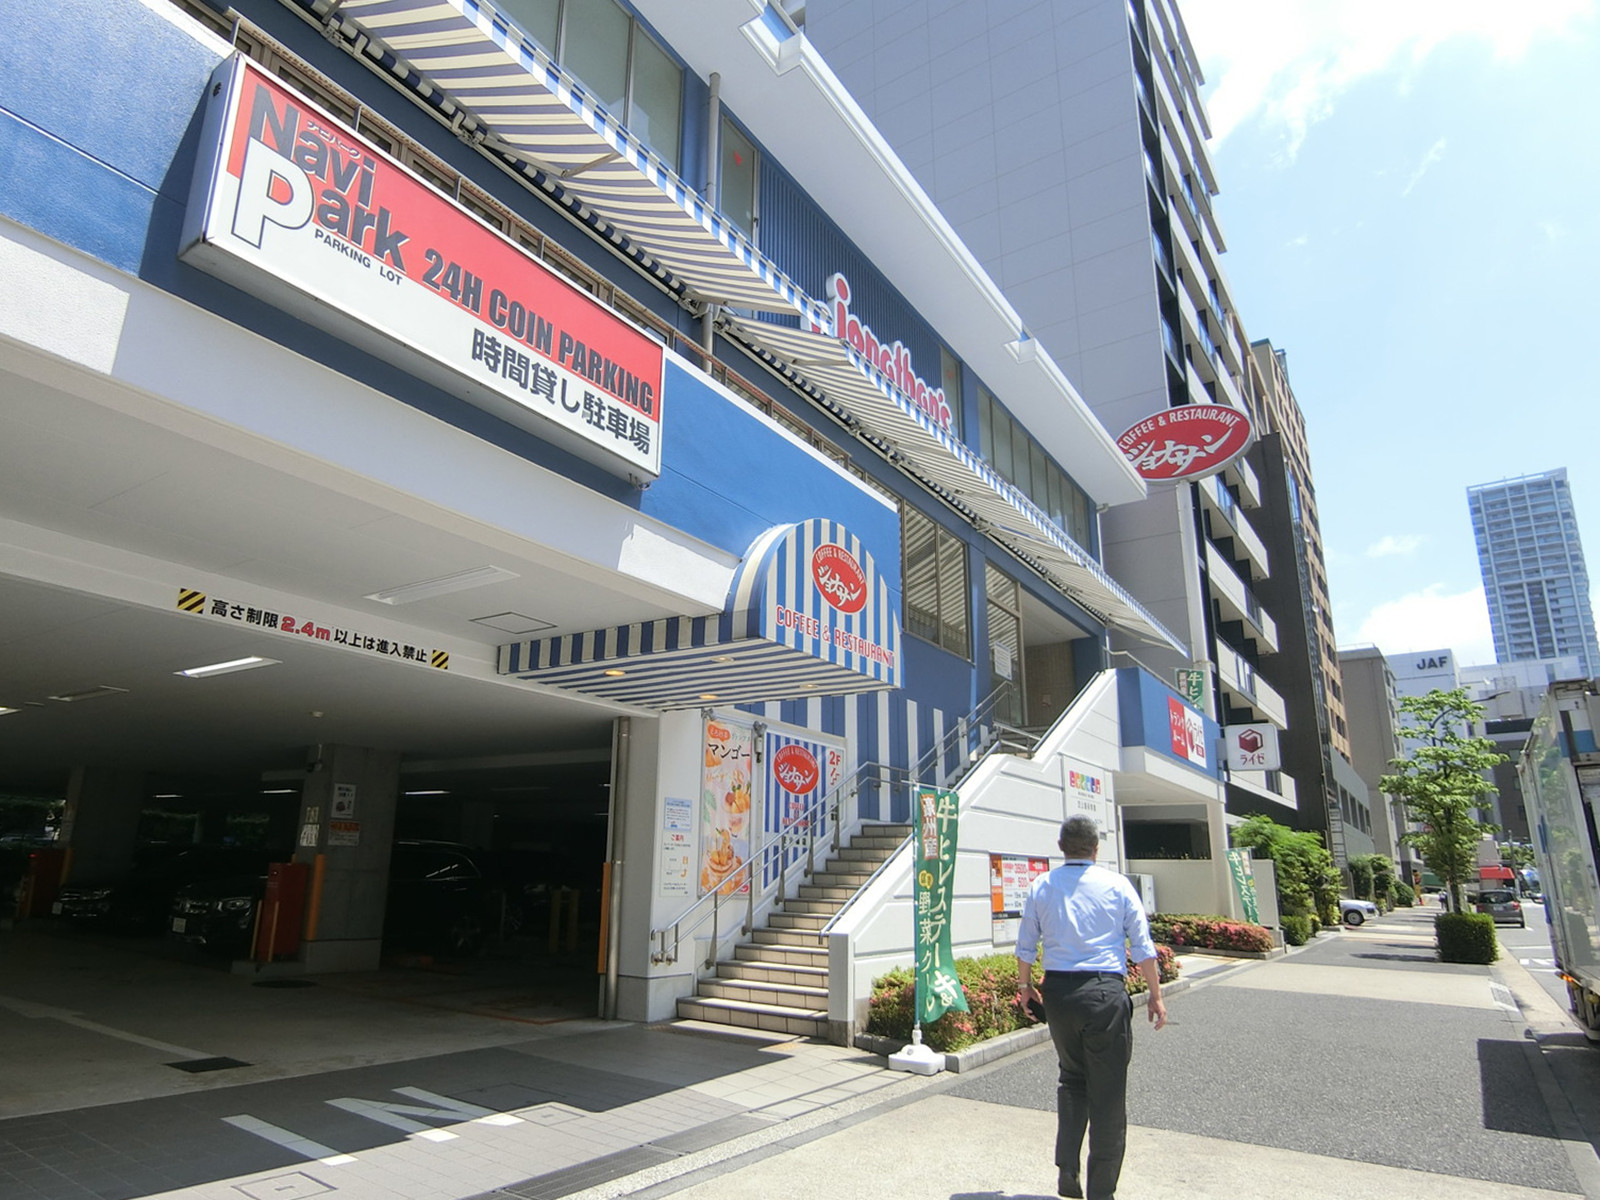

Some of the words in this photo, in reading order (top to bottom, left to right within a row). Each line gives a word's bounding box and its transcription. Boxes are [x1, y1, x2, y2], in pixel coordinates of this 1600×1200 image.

[249, 84, 377, 210] Navi
[307, 120, 362, 160] ナビパーク
[231, 136, 411, 275] Park
[314, 229, 371, 269] PARKING
[379, 264, 403, 286] LOT
[422, 248, 484, 313] 24H
[489, 288, 553, 355] COIN
[558, 333, 654, 415] PARKING
[471, 327, 652, 456] 時間貸し駐車場
[1118, 420, 1155, 450] COFFEE
[1158, 416, 1166, 426] &
[1169, 408, 1240, 427] RESTAURANT
[211, 598, 428, 663] 高さ制限2.4m以上は進入禁止
[777, 606, 819, 639] COFFEE
[822, 625, 831, 643] &
[834, 629, 894, 668] RESTAURANT
[1417, 656, 1447, 670] JAF
[707, 743, 750, 759] マンゴー
[829, 751, 841, 766] 2F
[1240, 753, 1265, 766] ライゼ
